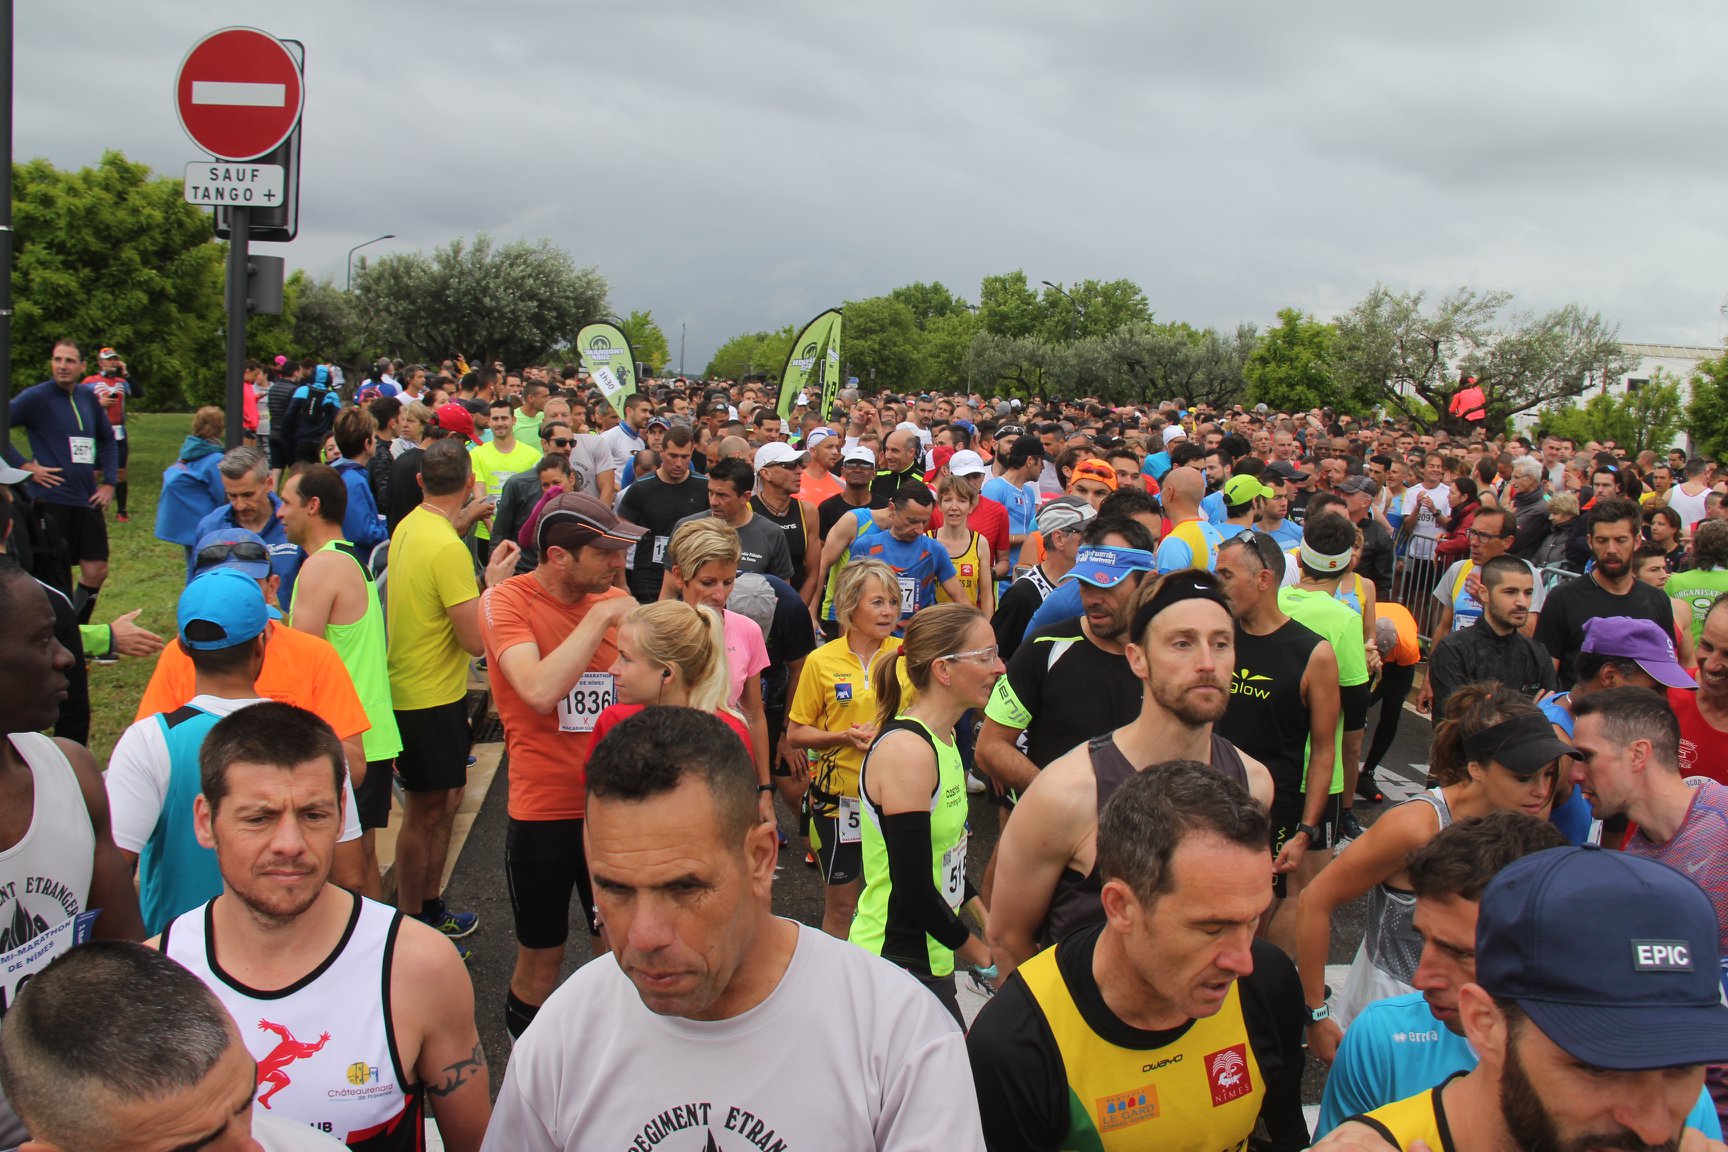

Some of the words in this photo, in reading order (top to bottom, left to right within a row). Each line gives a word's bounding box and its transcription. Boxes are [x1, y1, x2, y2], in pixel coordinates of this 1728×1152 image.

[209, 167, 260, 182] SAUF
[192, 186, 253, 201] TANGO
[599, 371, 615, 390] 1h30
[562, 690, 611, 715] 1836
[836, 691, 850, 699] AXA
[26, 876, 79, 918] ETRANGER
[1637, 945, 1690, 966] EPIC
[8, 961, 23, 973] DE
[327, 1083, 394, 1098] Châteaurenard
[1102, 1115, 1118, 1125] LE
[1121, 1104, 1155, 1120] GARD
